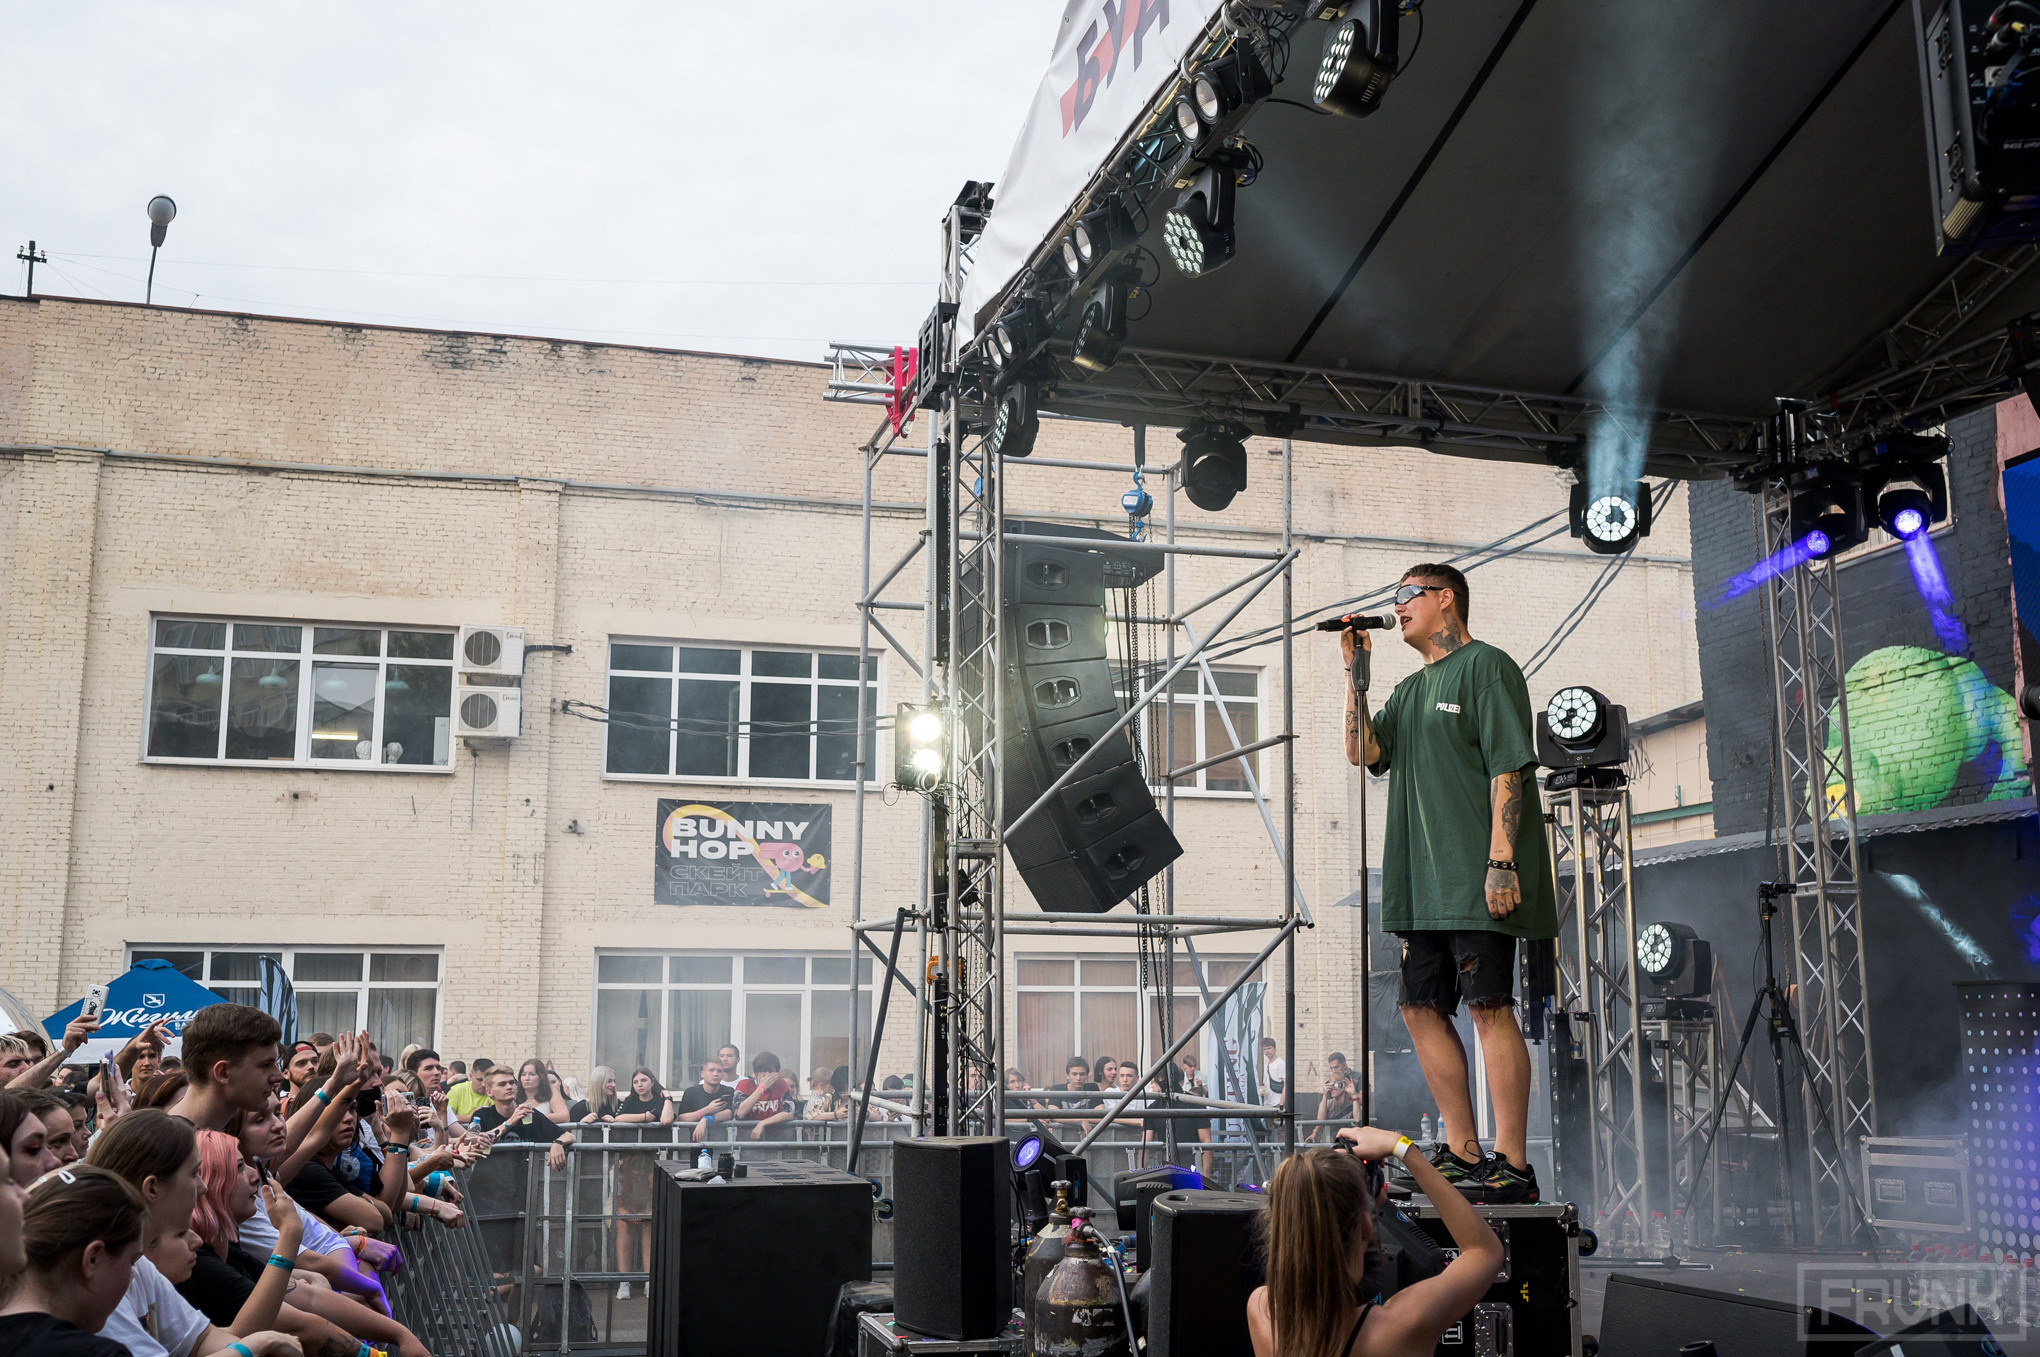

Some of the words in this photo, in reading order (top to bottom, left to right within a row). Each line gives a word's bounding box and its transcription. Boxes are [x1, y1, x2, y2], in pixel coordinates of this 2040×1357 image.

[672, 818, 810, 840] BUNNY
[670, 839, 754, 860] HOP
[670, 863, 763, 881] СКЕЙТ
[670, 882, 748, 898] ПАРК
